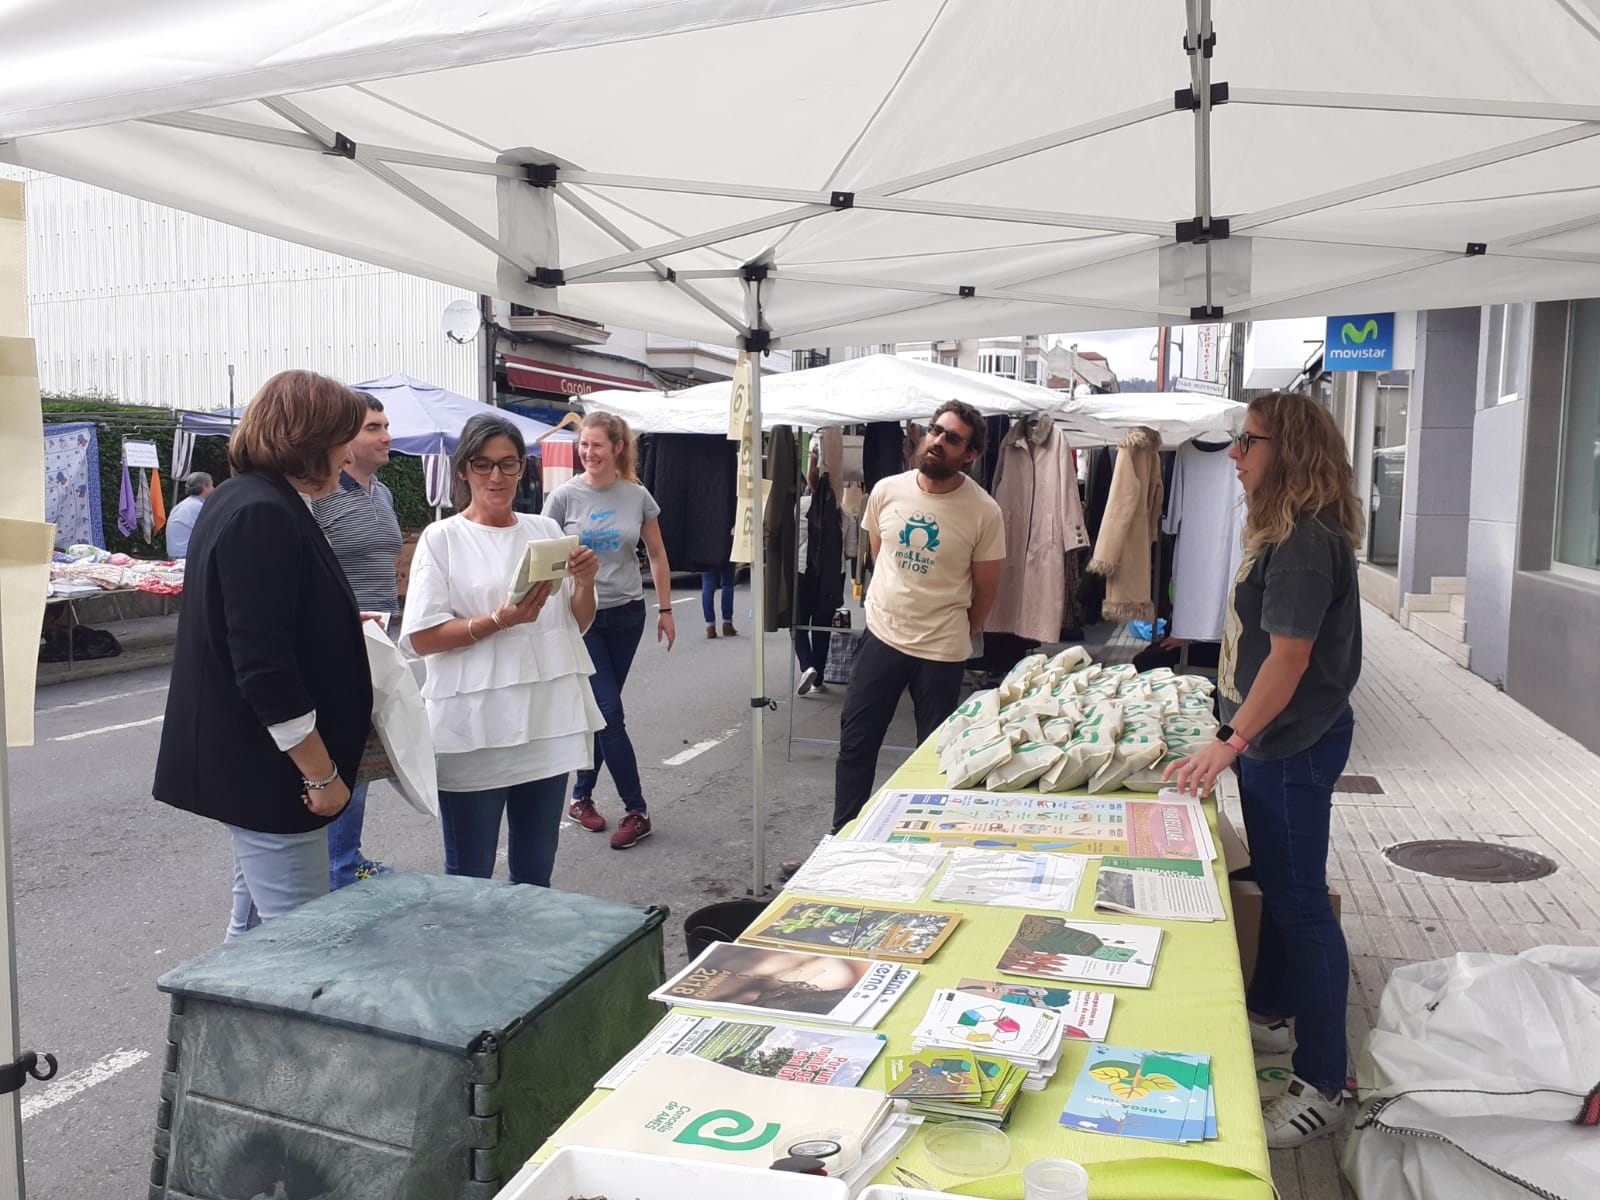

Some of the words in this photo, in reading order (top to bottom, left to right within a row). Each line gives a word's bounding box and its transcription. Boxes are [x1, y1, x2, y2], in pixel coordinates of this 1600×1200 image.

[1330, 348, 1386, 359] movistar
[672, 966, 718, 995] 2018
[695, 969, 732, 998] ANUARIO
[863, 963, 894, 992] cerna
[791, 1049, 811, 1067] con
[809, 1046, 834, 1072] monte
[830, 1057, 850, 1072] Por
[814, 1071, 834, 1085] un
[665, 1101, 678, 1111] de
[644, 1110, 670, 1131] AMES
[656, 1105, 691, 1133] Concello
